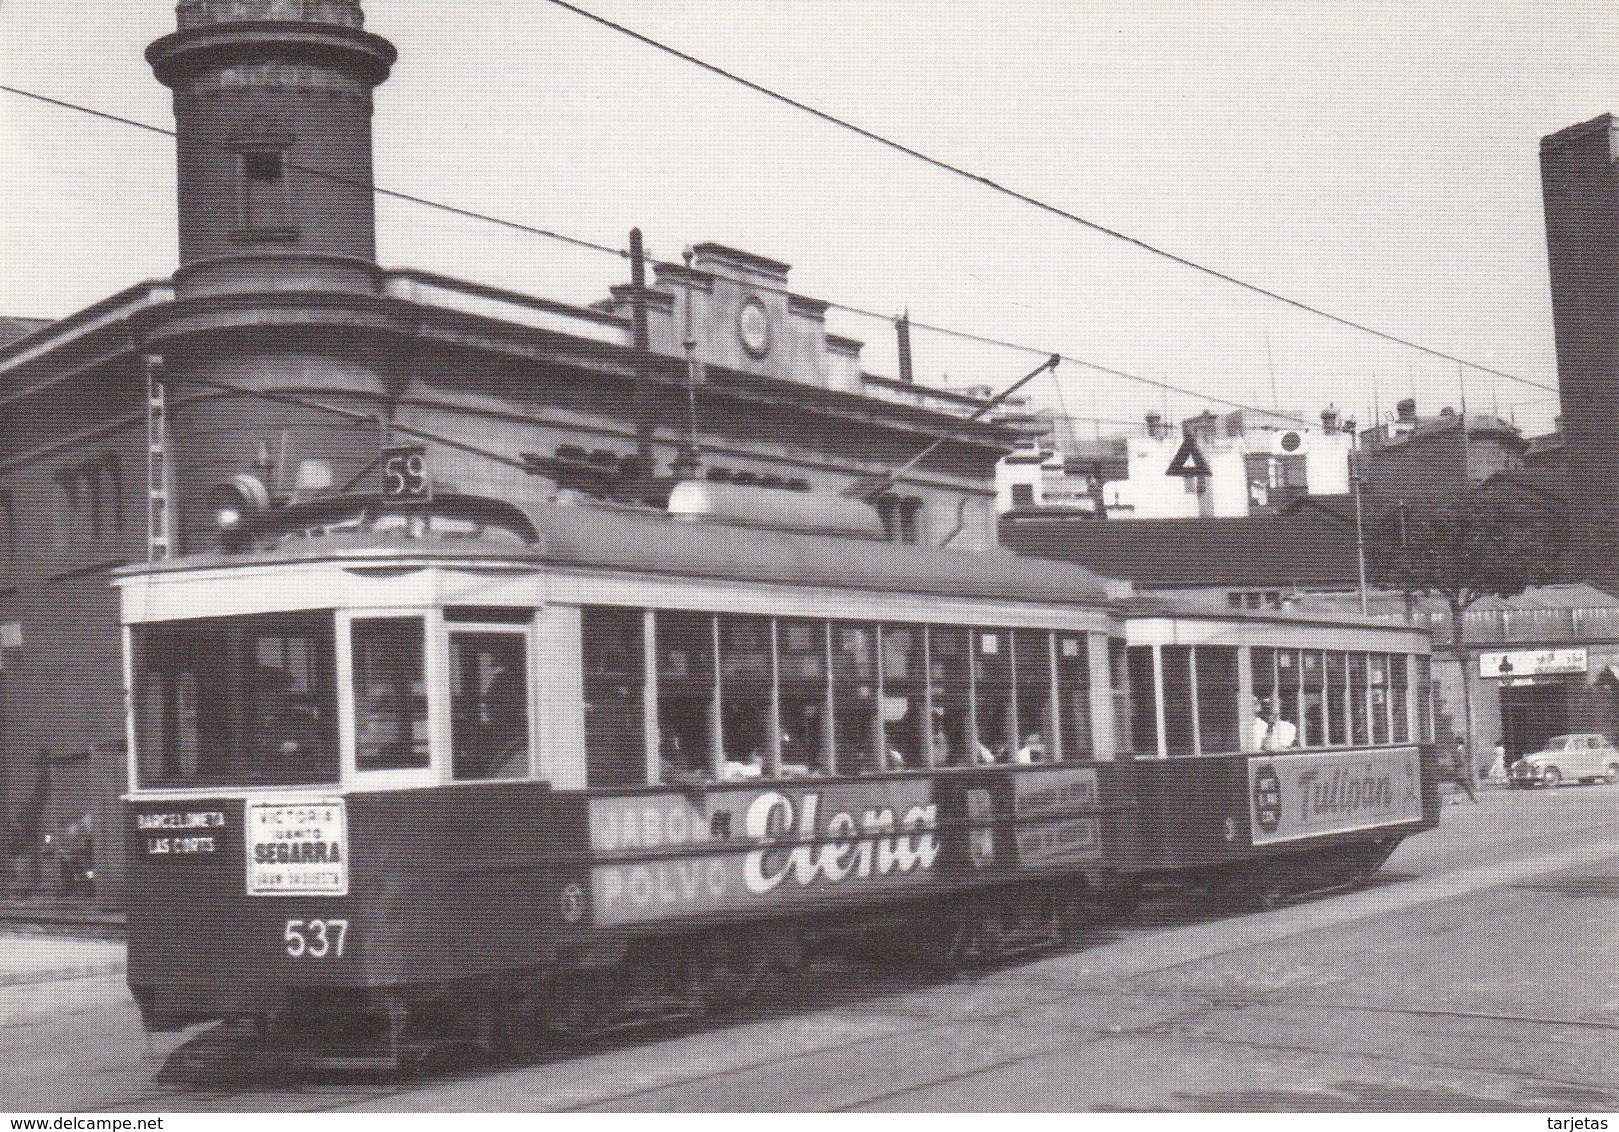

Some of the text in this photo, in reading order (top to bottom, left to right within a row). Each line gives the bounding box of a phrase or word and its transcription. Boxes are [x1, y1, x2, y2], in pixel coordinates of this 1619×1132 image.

[386, 454, 428, 495] 59
[137, 812, 225, 829] BARCELONETA
[147, 837, 170, 854] LAS
[254, 841, 341, 864] SEGARRA
[743, 790, 941, 894] Elena
[603, 860, 728, 911] POLVO
[284, 919, 349, 958] 537
